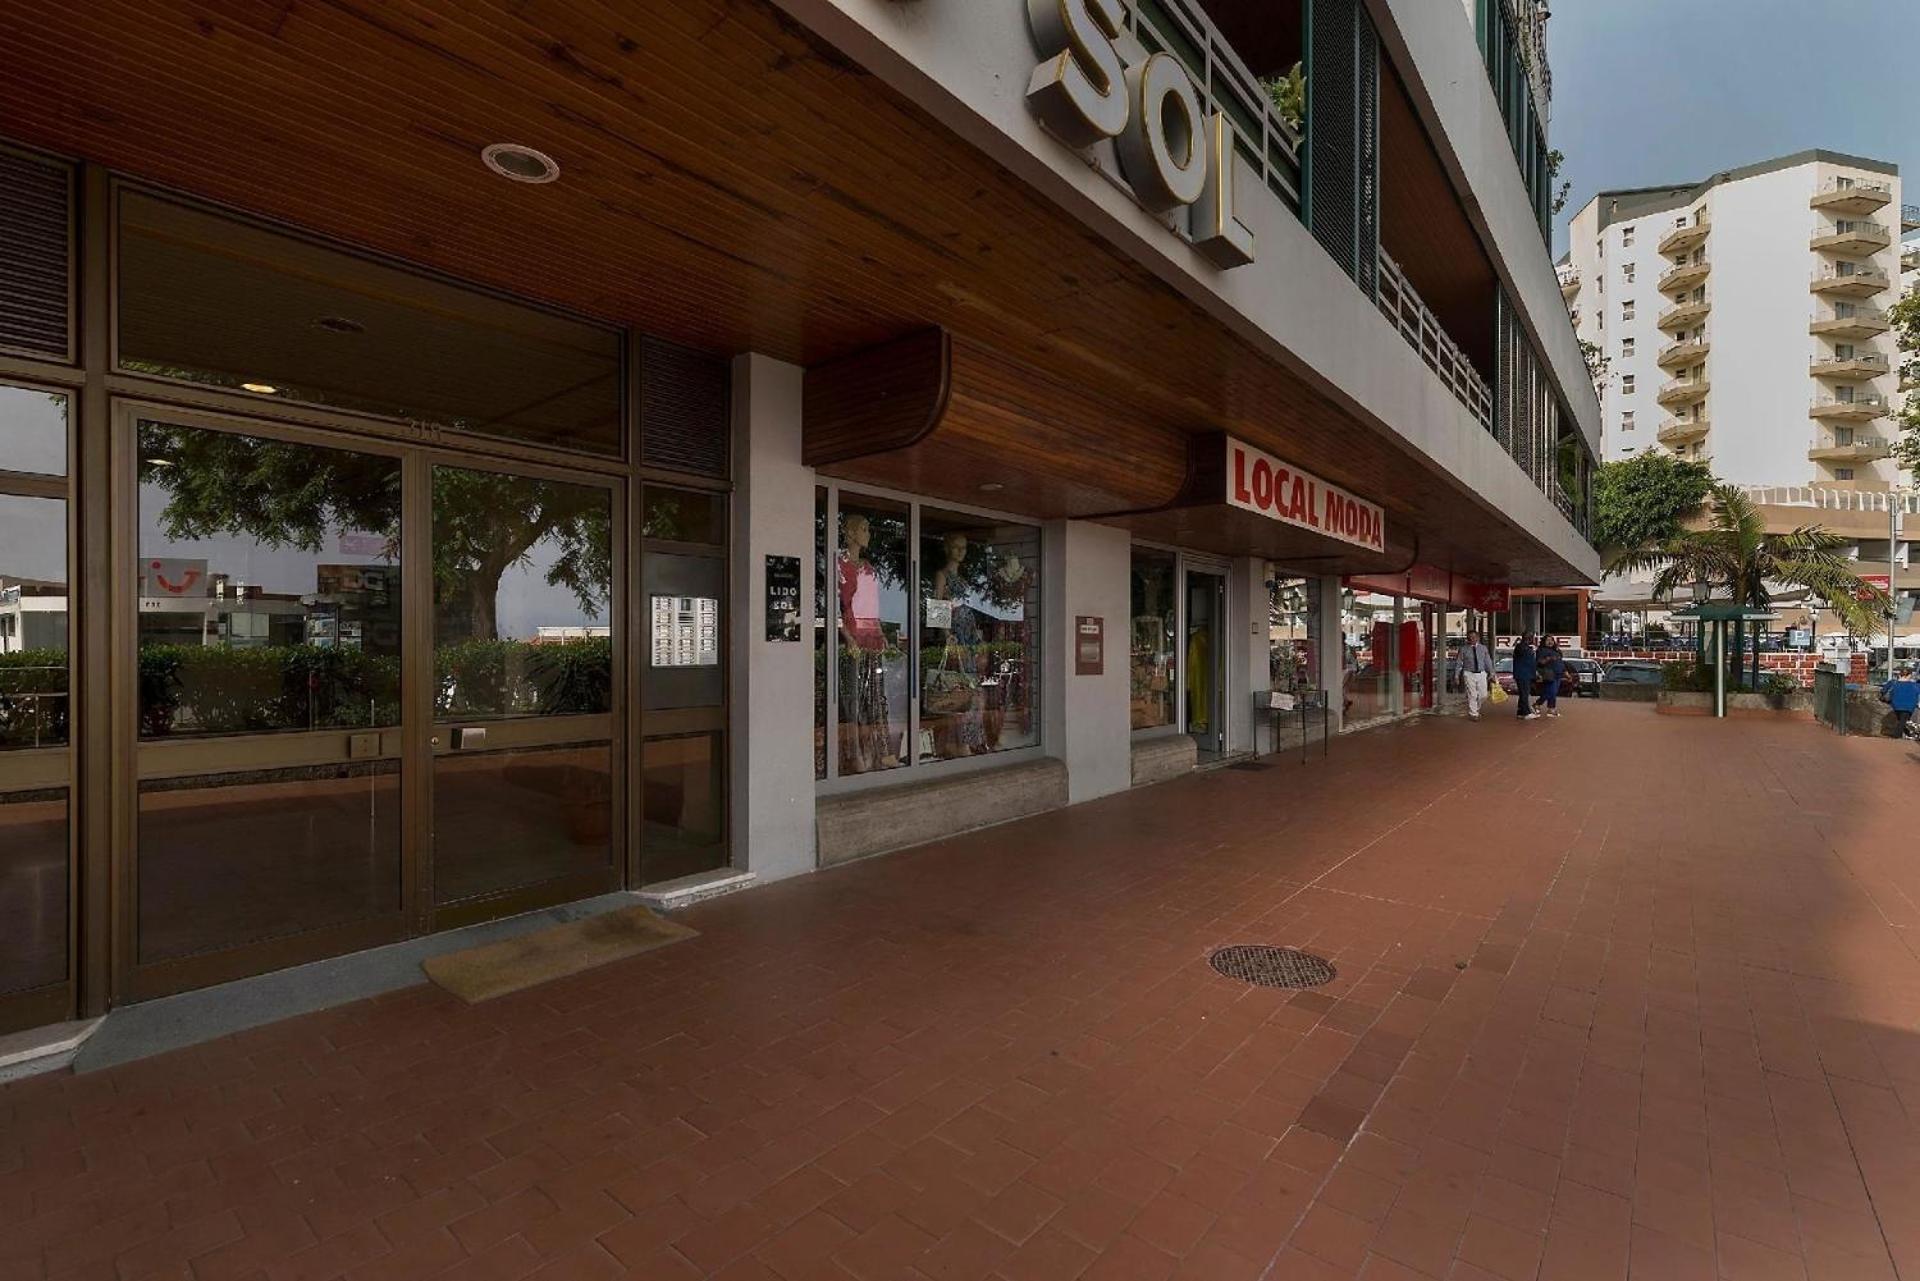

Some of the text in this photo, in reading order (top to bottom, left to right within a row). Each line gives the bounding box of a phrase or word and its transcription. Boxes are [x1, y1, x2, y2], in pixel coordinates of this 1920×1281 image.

[1027, 0, 1254, 270] SOL
[1235, 448, 1383, 549] LOCAL MODA
[769, 585, 798, 596] LIDO
[1795, 630, 1805, 642] P
